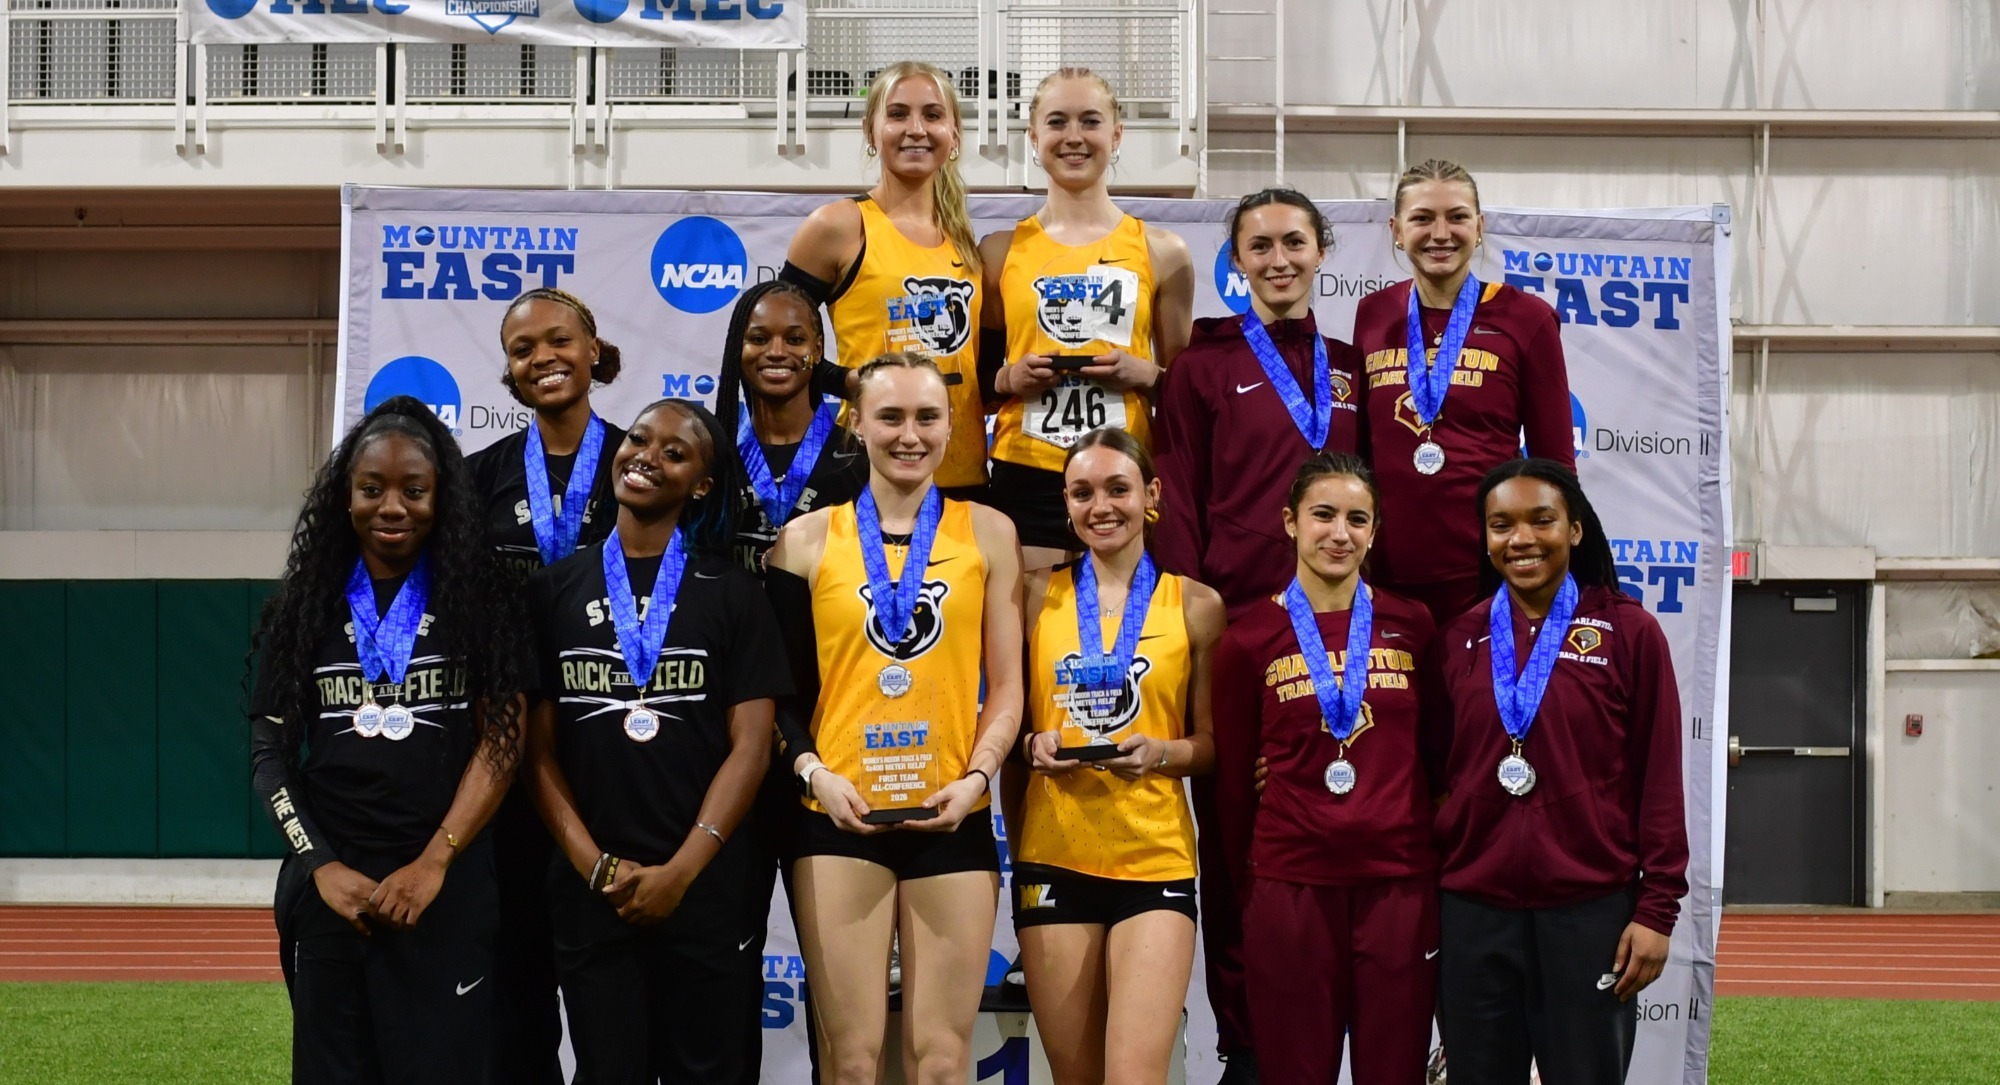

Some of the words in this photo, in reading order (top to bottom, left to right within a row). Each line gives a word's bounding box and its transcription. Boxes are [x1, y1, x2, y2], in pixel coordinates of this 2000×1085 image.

[447, 0, 538, 15] CHAMPIONSHIP
[381, 252, 576, 301] EAST
[660, 263, 743, 289] NCAA
[1044, 284, 1103, 298] EAST
[887, 300, 946, 321] EAST
[1091, 279, 1127, 326] 4
[1041, 387, 1106, 434] 246
[1596, 429, 1690, 455] Division
[1700, 433, 1710, 456] II
[1609, 539, 1698, 563] TAIN
[1615, 565, 1695, 613] ST
[1586, 656, 1608, 666] FIELD
[562, 660, 612, 693] RACK
[653, 660, 704, 691] IELD
[1055, 665, 1118, 685] EAST
[1369, 673, 1409, 689] FIELD
[1090, 709, 1109, 717] TEAM
[865, 730, 928, 749] EAST
[884, 763, 906, 771] METER
[907, 761, 926, 769] RELAY
[871, 781, 926, 792] ALL-CONFERENCE
[879, 775, 898, 783] FIRST
[899, 773, 918, 781] TEAM
[270, 787, 295, 821] THE
[283, 816, 313, 855] NEST
